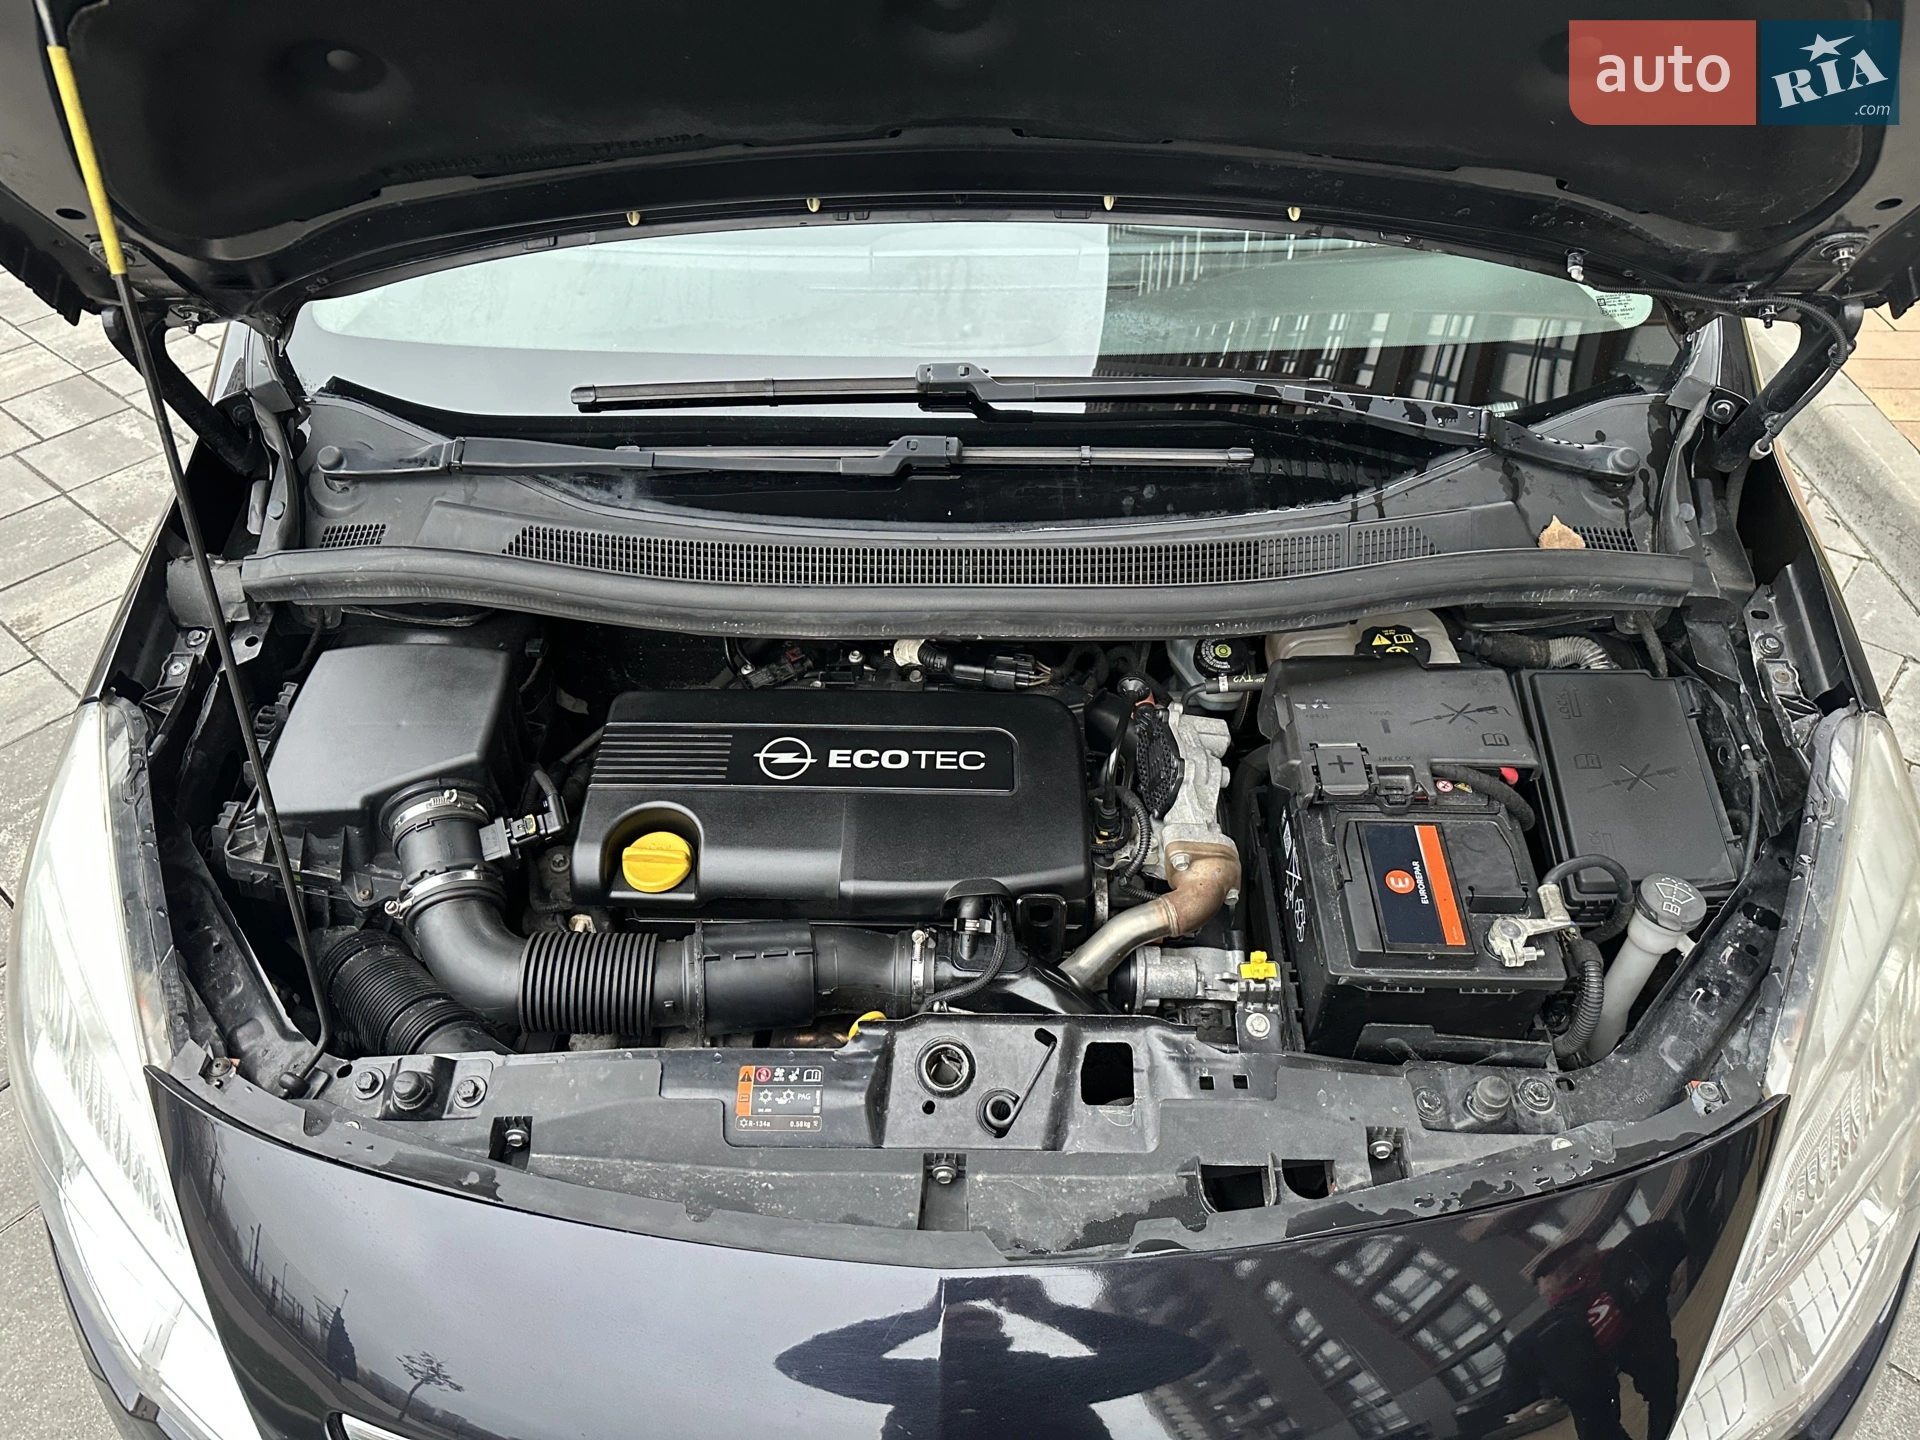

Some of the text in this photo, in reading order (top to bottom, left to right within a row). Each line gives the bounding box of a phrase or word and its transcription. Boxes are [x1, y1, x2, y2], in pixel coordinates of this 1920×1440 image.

[1555, 692, 1571, 720] LOCK
[828, 749, 986, 770] ECOTEC
[1412, 861, 1429, 904] EUROREPAR
[797, 1092, 811, 1100] PAG
[748, 1120, 771, 1128] R-134a
